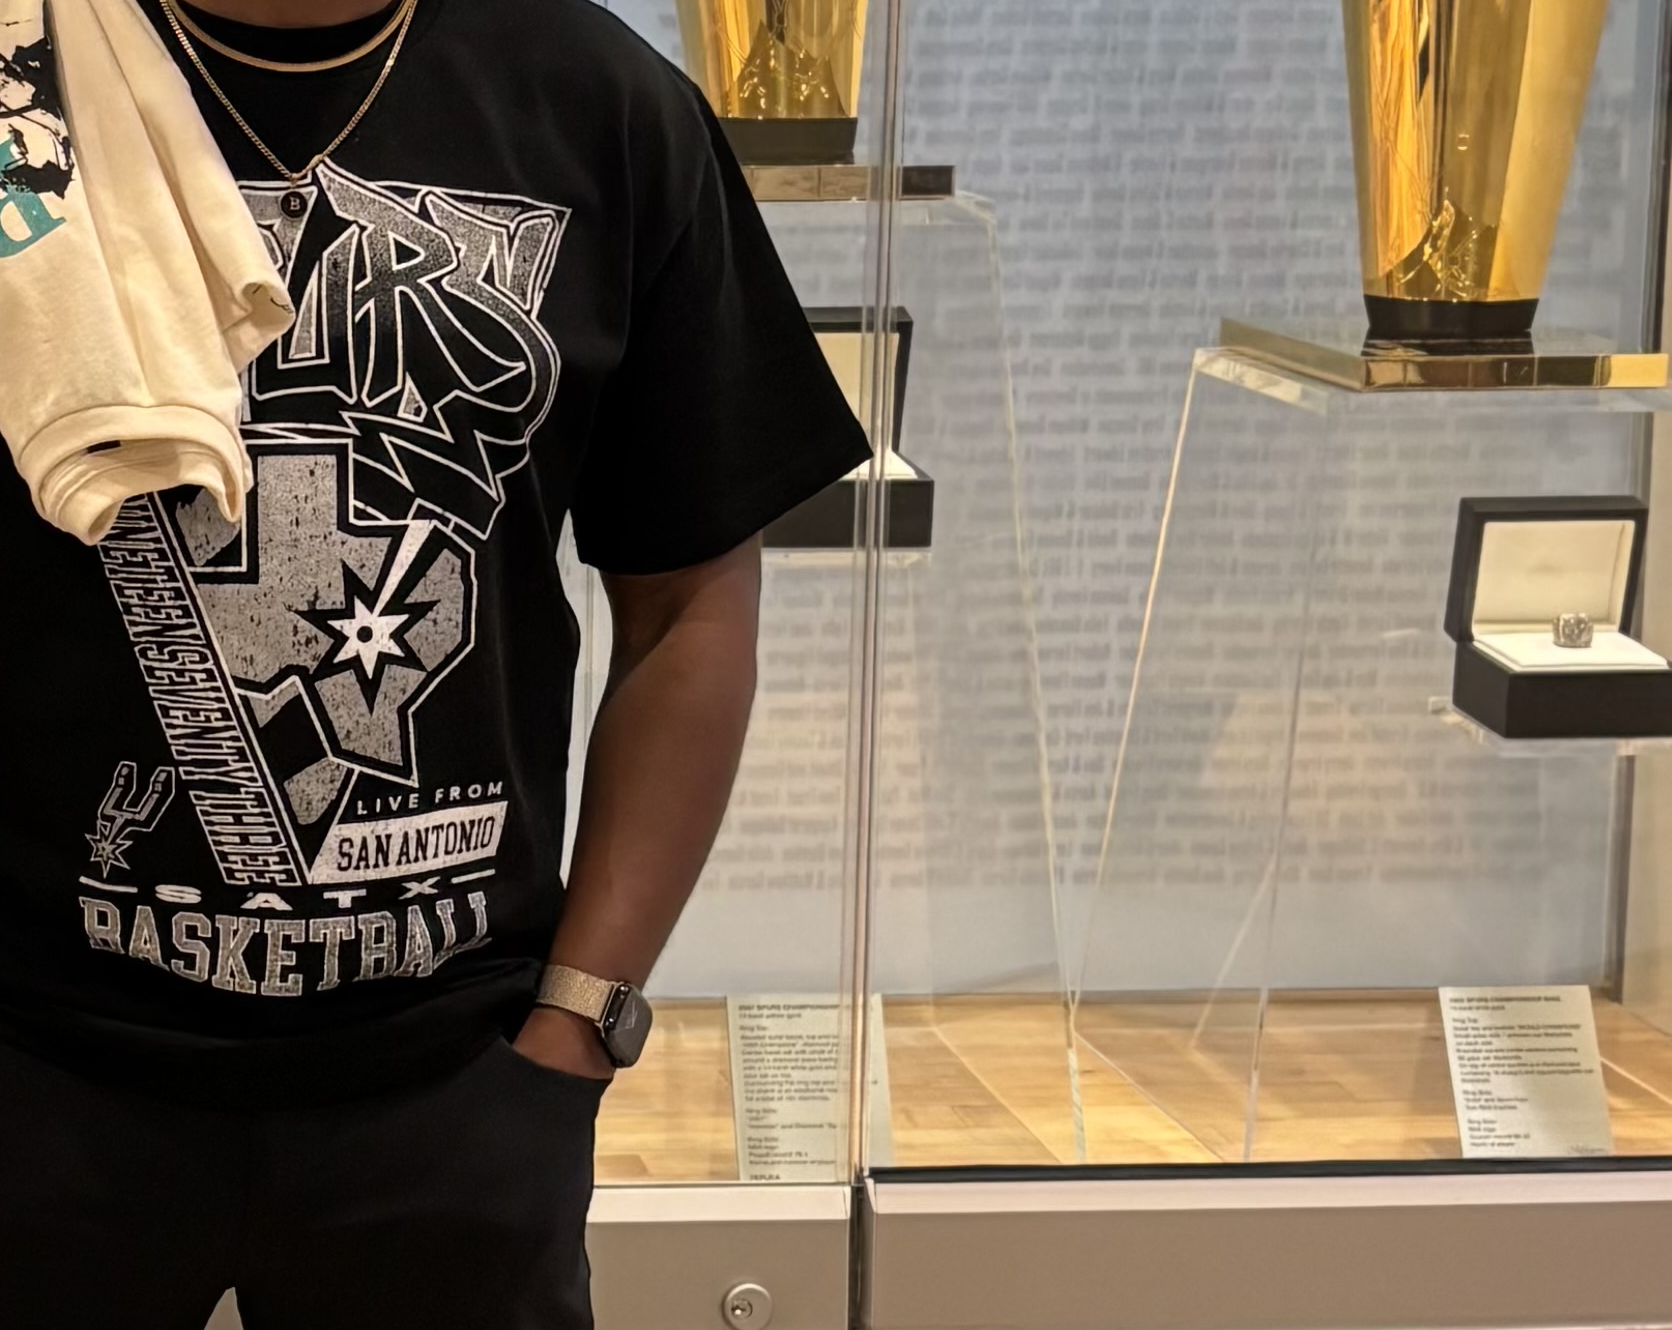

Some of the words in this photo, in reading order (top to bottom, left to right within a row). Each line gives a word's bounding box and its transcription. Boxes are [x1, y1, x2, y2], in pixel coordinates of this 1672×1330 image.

[189, 787, 303, 886] THREE
[357, 792, 420, 816] LIVE
[434, 780, 504, 804] FROM
[336, 833, 391, 872] SAN
[394, 815, 498, 866] ANTONIO
[78, 890, 493, 997] BASKETBALL
